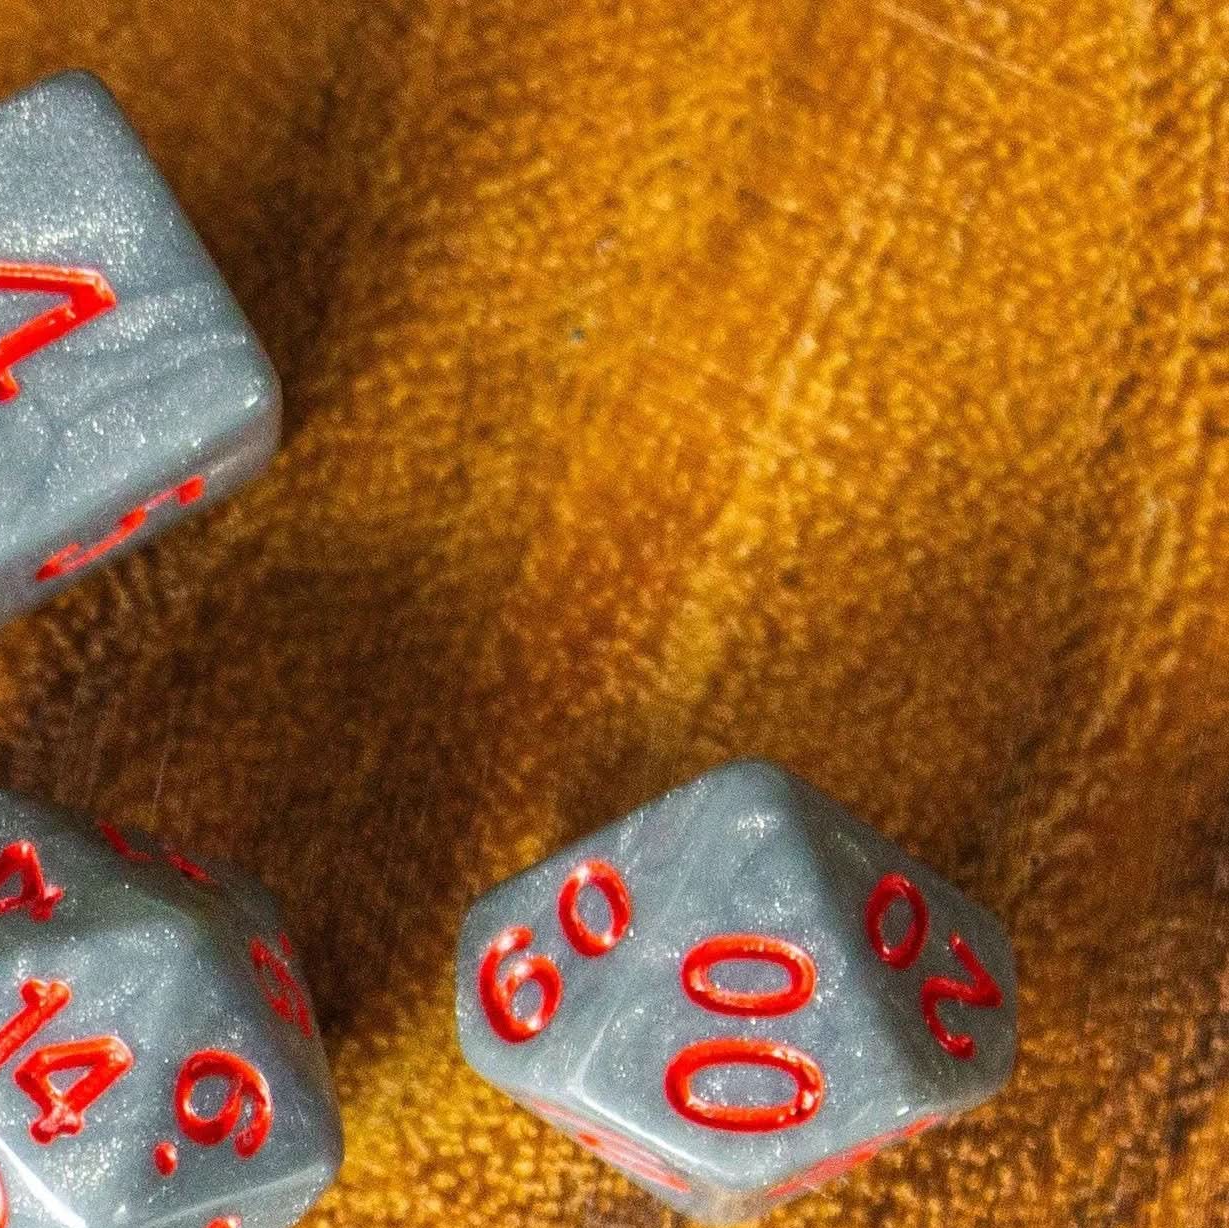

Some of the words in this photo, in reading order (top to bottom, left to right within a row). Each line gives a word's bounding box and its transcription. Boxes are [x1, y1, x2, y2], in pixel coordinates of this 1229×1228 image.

[475, 858, 632, 1047] 60
[664, 934, 824, 1136] 00
[863, 871, 1004, 1063] 20
